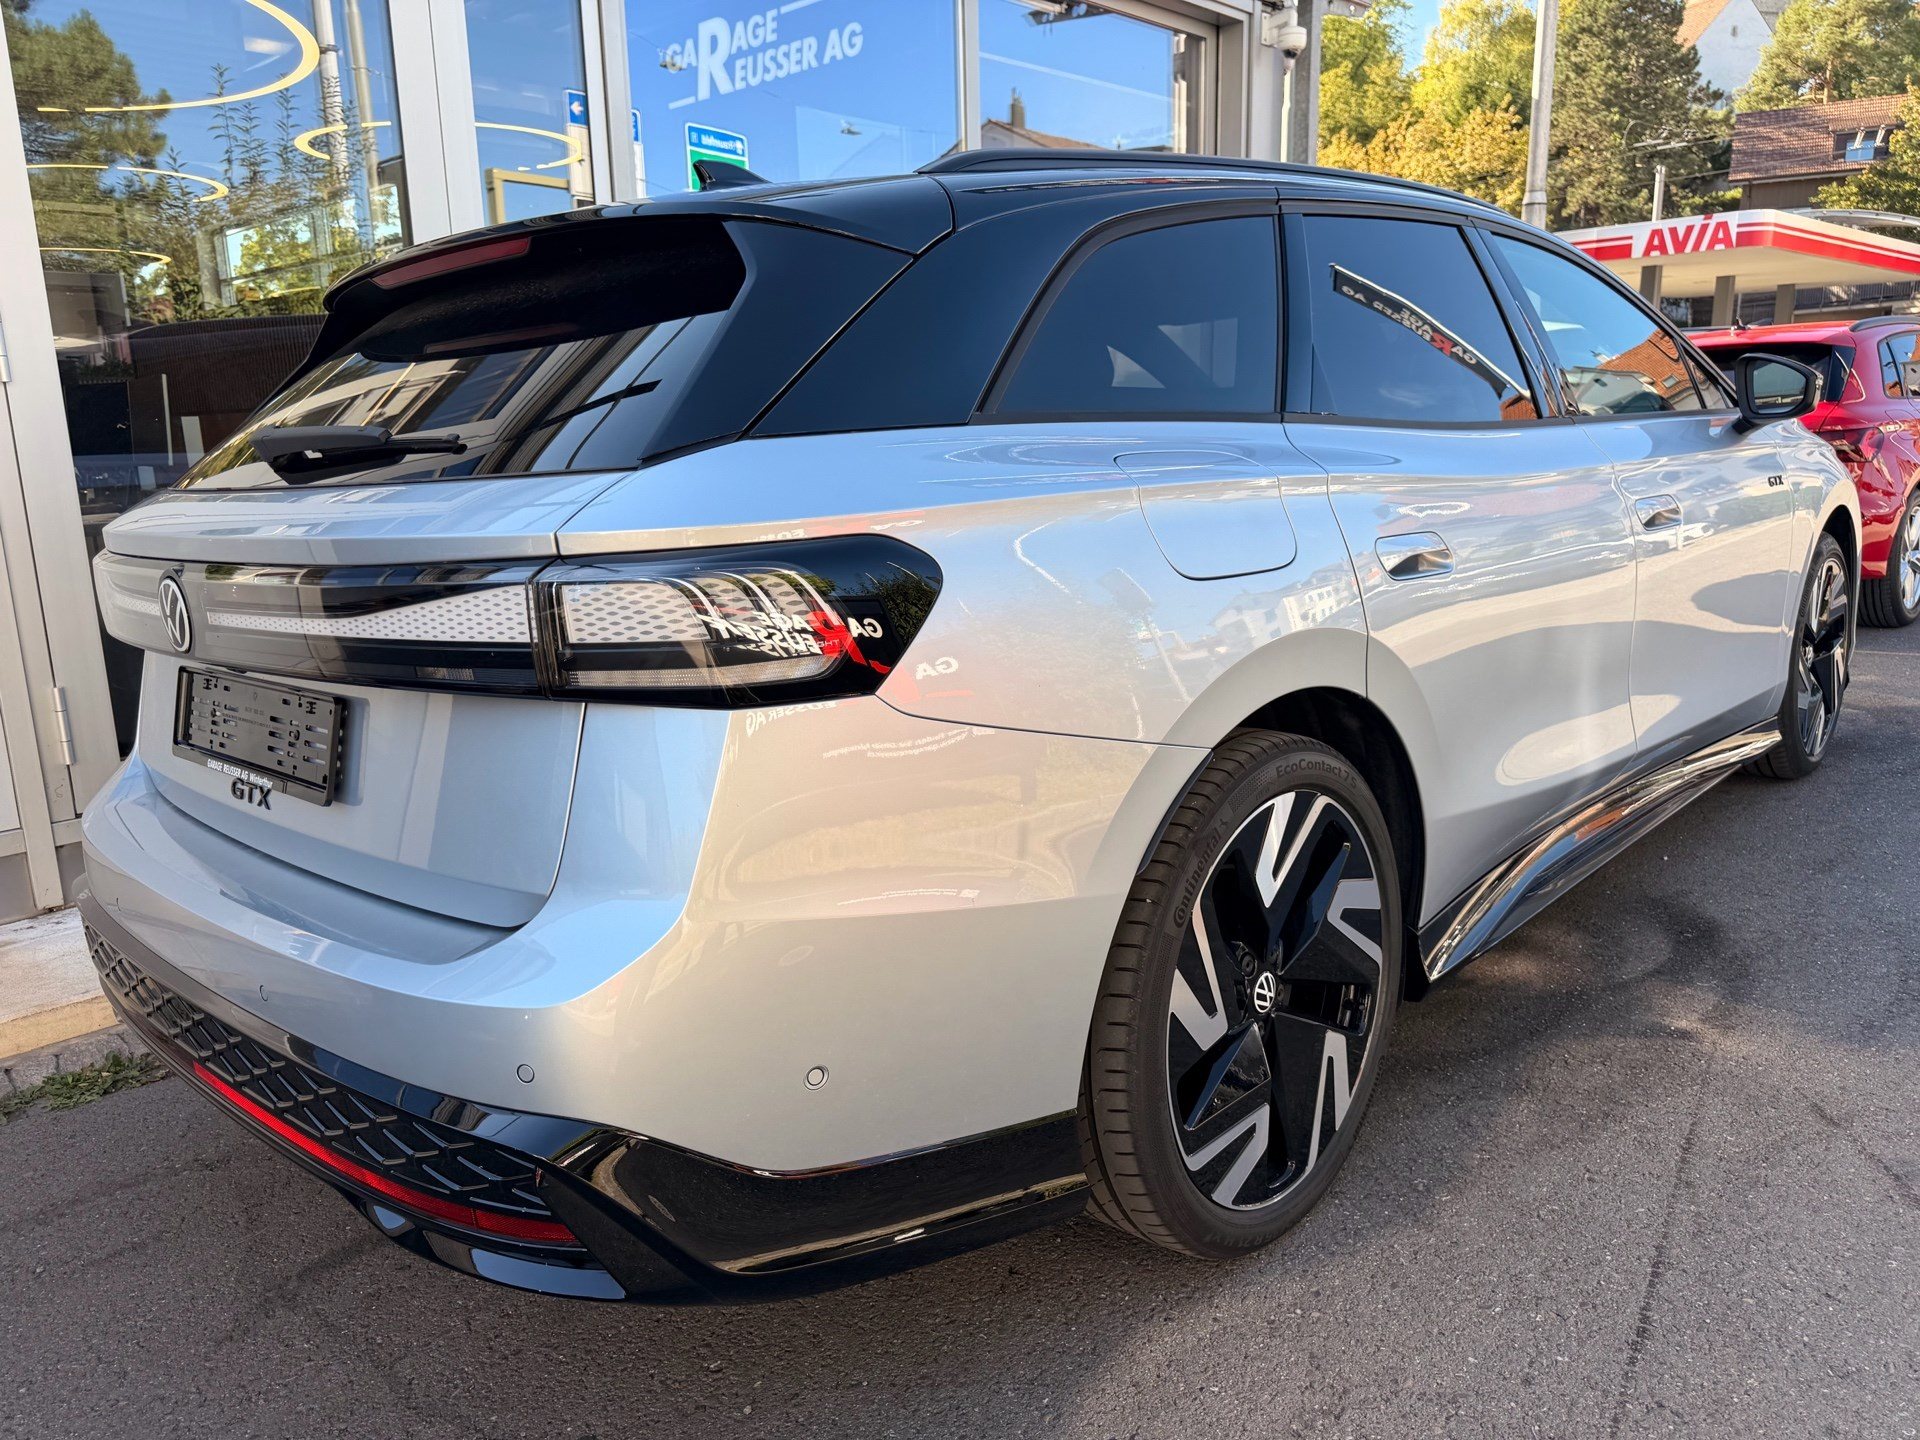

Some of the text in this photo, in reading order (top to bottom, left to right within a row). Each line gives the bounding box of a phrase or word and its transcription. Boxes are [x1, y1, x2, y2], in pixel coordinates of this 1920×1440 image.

[666, 8, 778, 101] GARAGE
[823, 22, 864, 64] AG
[1643, 214, 1734, 257] AVIA
[1768, 475, 1784, 487] GTX
[207, 758, 223, 772] GARAGE
[223, 763, 241, 778] REUSSER
[241, 769, 249, 780] AG
[1276, 758, 1342, 778] EcoContact
[231, 777, 271, 810] GTX
[1173, 828, 1223, 929] Continental
